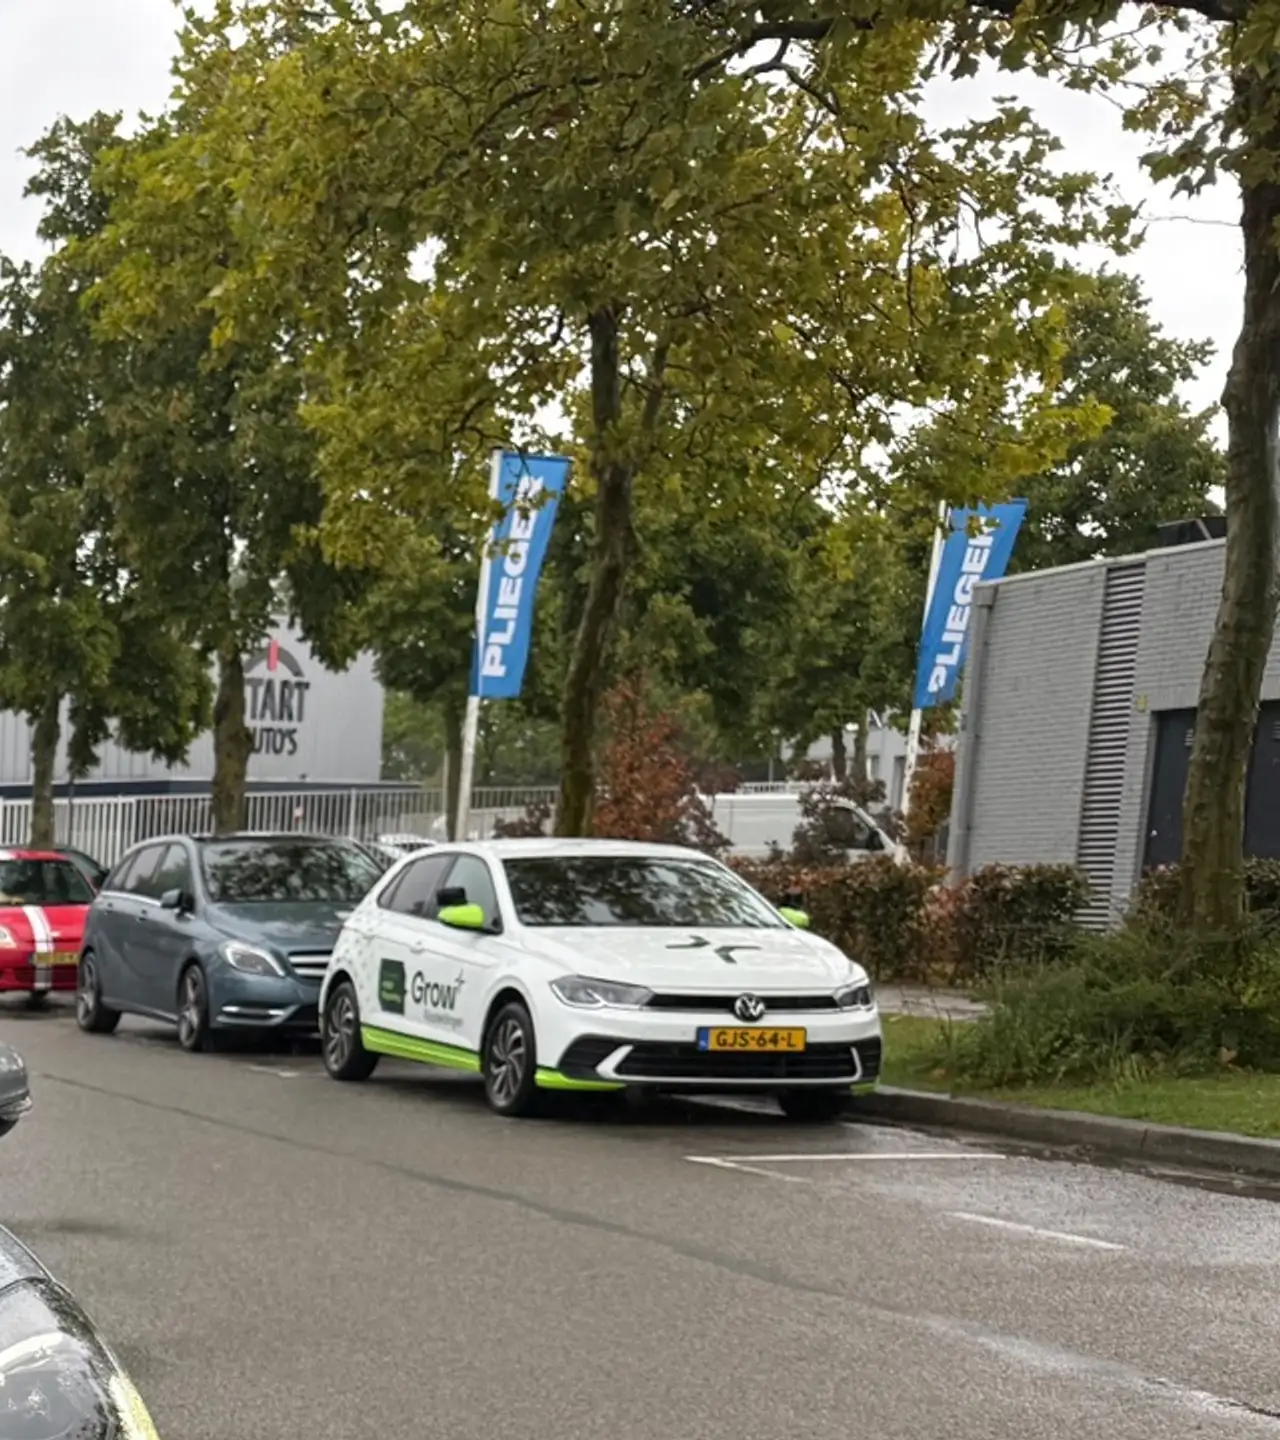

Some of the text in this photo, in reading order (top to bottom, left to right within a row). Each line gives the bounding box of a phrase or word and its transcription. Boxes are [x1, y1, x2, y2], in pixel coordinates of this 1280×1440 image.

[244, 677, 310, 723] TART
[251, 727, 298, 755] UTO'S
[411, 969, 458, 1011] Grow
[716, 1030, 796, 1048] GJS-64-L
